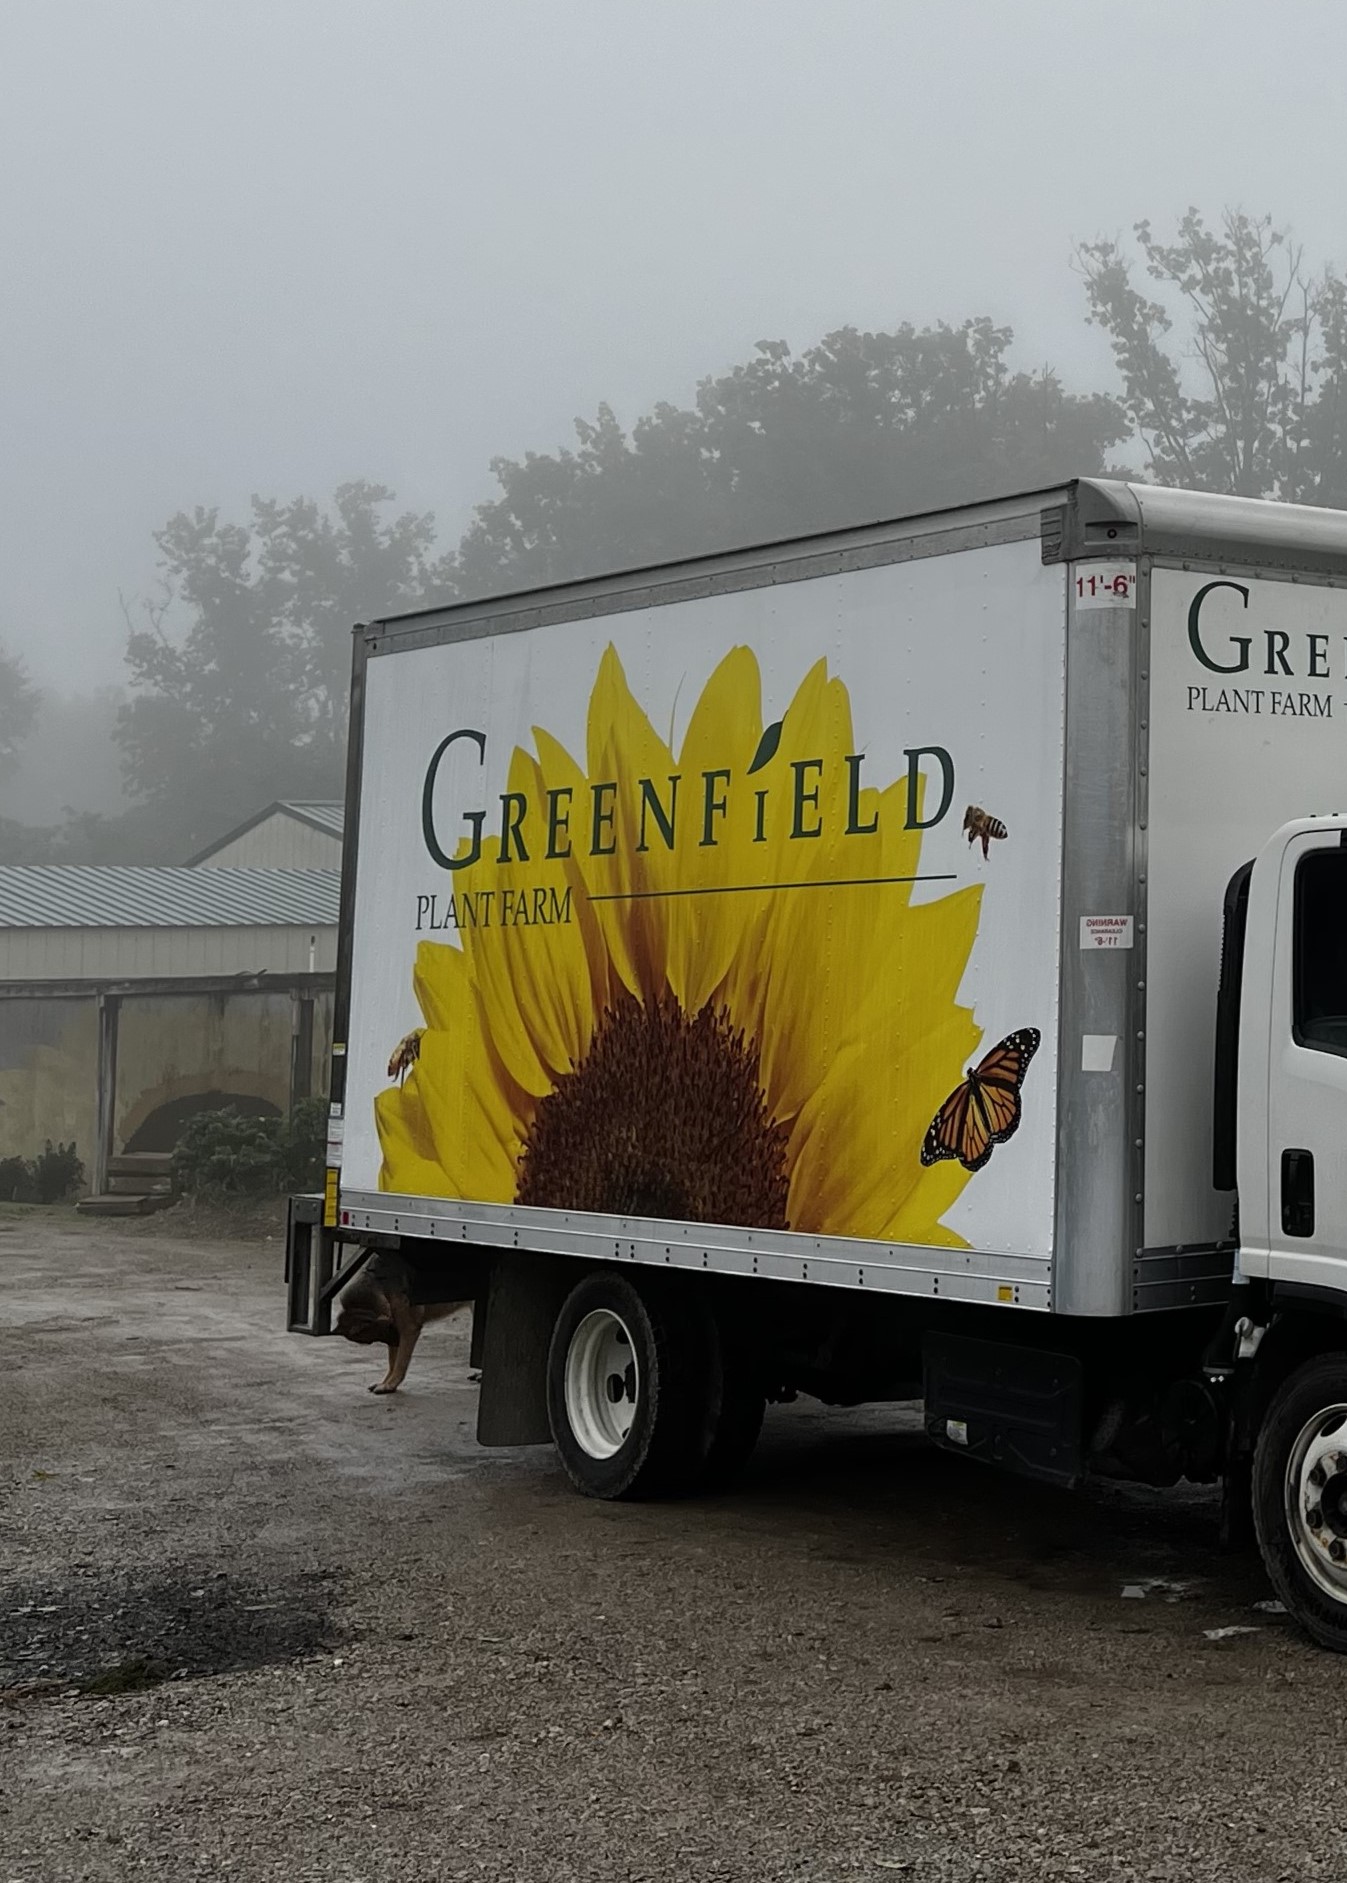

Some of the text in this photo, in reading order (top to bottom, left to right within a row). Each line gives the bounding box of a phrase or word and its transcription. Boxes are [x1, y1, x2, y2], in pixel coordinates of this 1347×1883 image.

[1187, 686, 1333, 718] PLANT FARM
[415, 886, 572, 931] PLANT FARM
